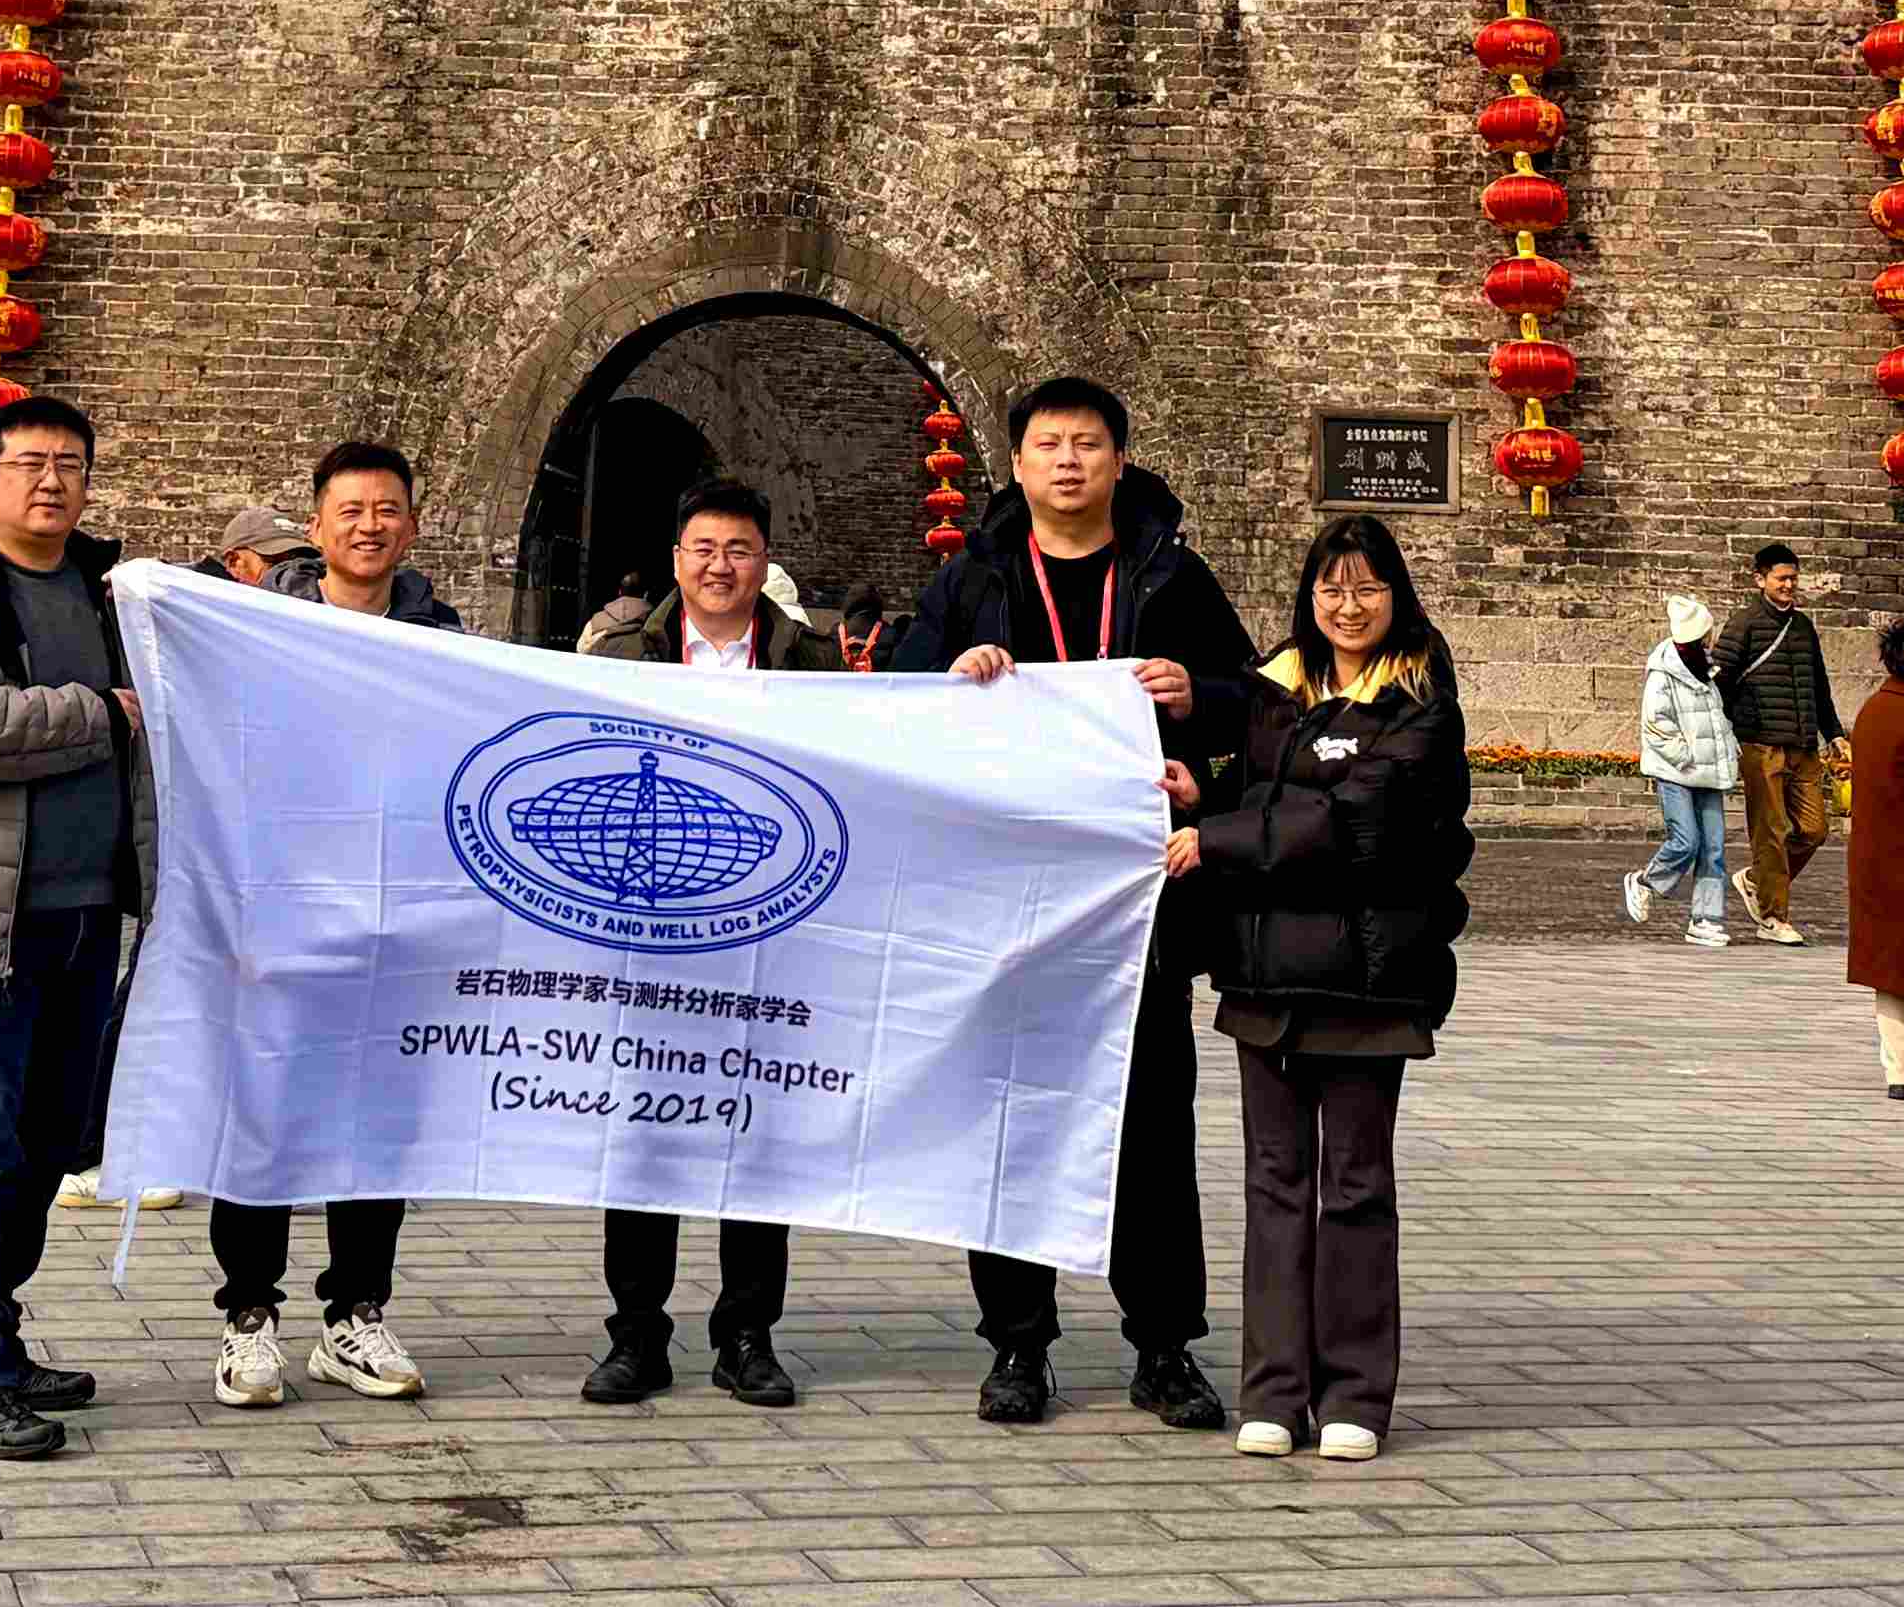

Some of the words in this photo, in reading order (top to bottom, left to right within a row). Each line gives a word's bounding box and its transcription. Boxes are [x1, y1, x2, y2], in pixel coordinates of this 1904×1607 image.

[589, 721, 676, 745] SOCIETY
[683, 738, 710, 751] OF
[456, 803, 599, 928] PETROPHYSICISTS
[602, 915, 645, 937] AND
[650, 923, 704, 940] WELL
[709, 915, 751, 937] LOG
[756, 847, 838, 926] ANALYSTS
[455, 968, 812, 1027] 岩石物理学家与测井分析家学会
[399, 1024, 602, 1064] SPWLA-SW
[611, 1035, 707, 1076] China
[720, 1047, 855, 1095] Chapter
[490, 1071, 621, 1116] (Since
[627, 1091, 753, 1134] 2019)
